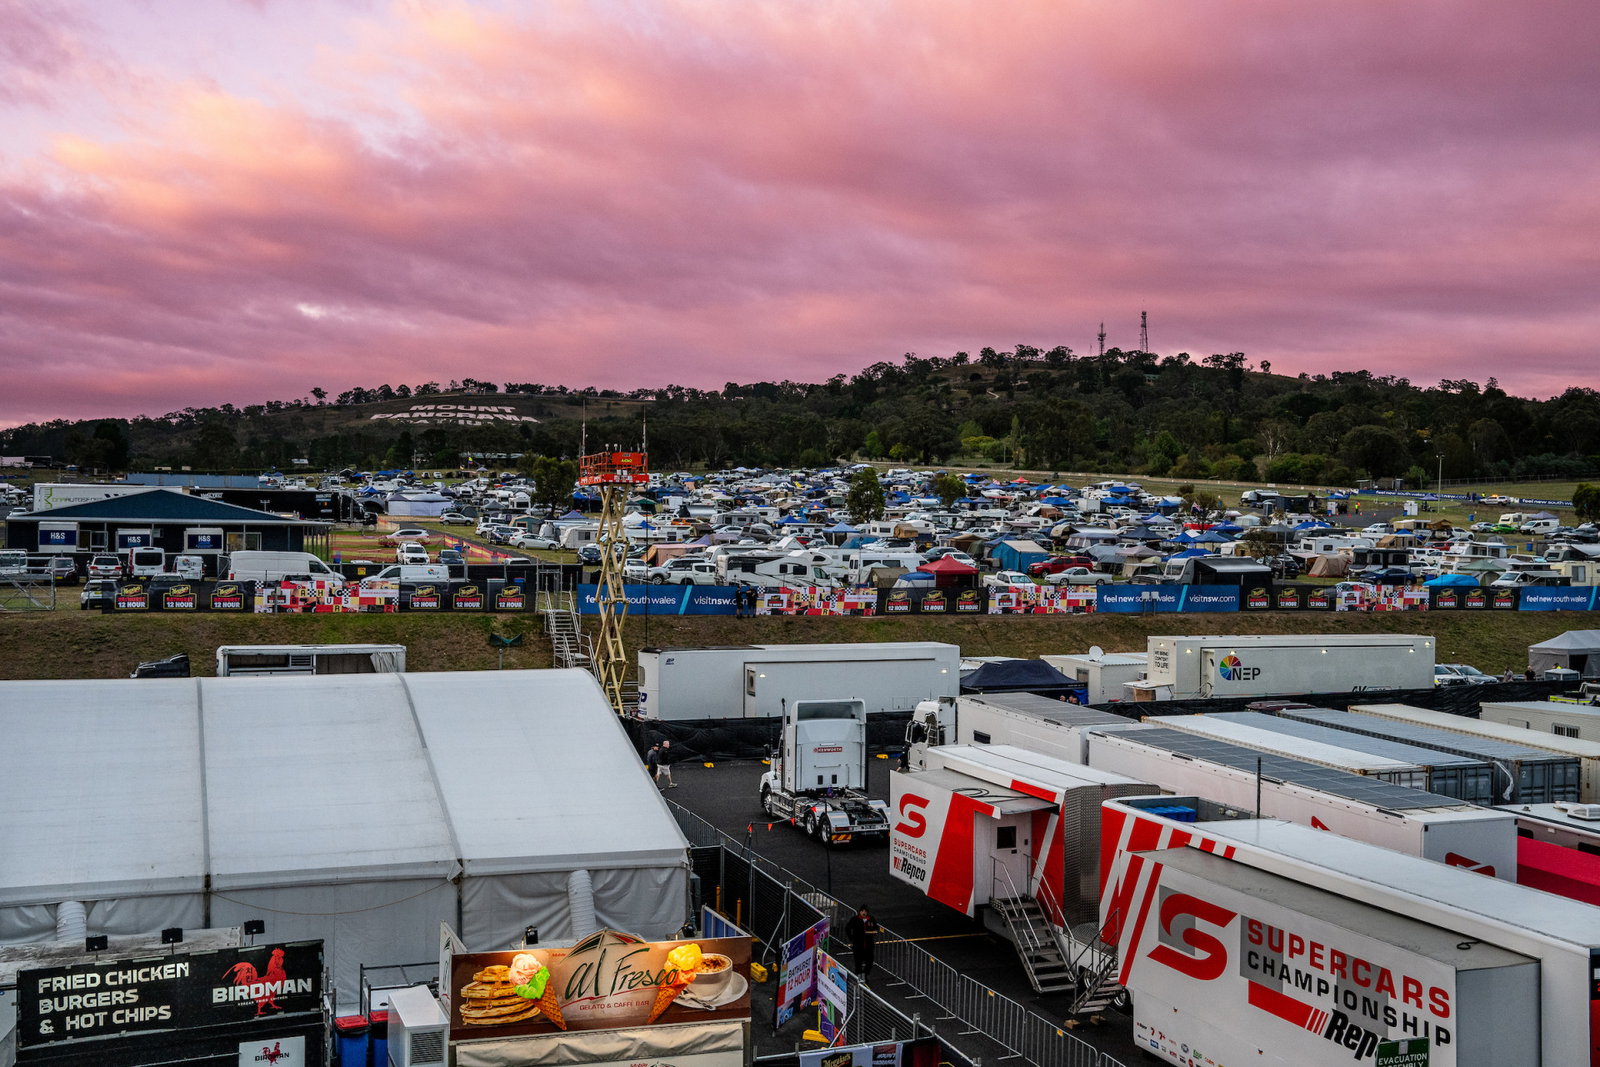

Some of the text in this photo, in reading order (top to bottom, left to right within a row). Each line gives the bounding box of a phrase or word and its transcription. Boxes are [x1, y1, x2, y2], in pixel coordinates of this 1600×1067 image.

[369, 412, 541, 423] PANORAMA
[410, 404, 516, 413] MOUNT
[585, 594, 603, 604] fel
[651, 595, 677, 604] wales
[694, 595, 748, 605] visitnsw.cm
[1232, 667, 1261, 681] NEP
[893, 837, 927, 859] SUPERCARS
[893, 846, 927, 865] CHAMPIONSHIP
[901, 856, 926, 882] Repco
[38, 962, 190, 994] FRIED CHICKEN
[564, 947, 679, 1000] al Fresco
[1247, 918, 1450, 1019] SUPERCARS
[38, 988, 140, 1015] BURGERS
[212, 977, 312, 1004] BIRDMAN
[1247, 950, 1451, 1047] CHAMPIONSHIP
[39, 1005, 172, 1035] & HOT CHIPS
[1324, 1008, 1391, 1061] Rep
[1378, 1052, 1428, 1065] EVACUATION
